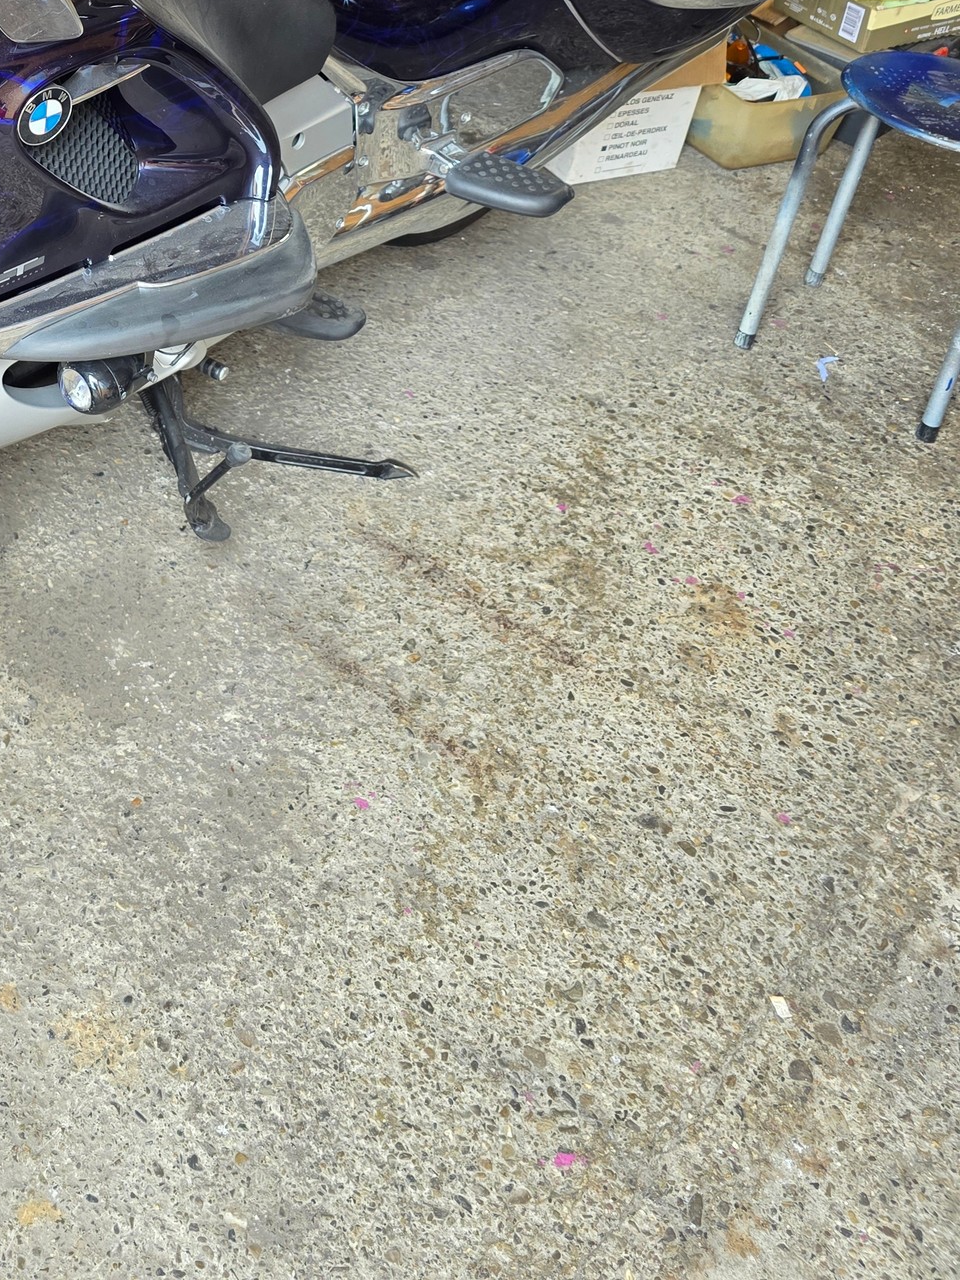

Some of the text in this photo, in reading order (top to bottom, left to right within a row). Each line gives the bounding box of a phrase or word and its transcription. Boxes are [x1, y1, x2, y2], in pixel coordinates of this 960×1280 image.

[25, 90, 68, 114] BMW
[617, 107, 650, 118] EPESSES
[614, 120, 639, 129] DORAL
[607, 139, 648, 151] PINOT NOIR
[604, 150, 648, 162] RENARDEAU
